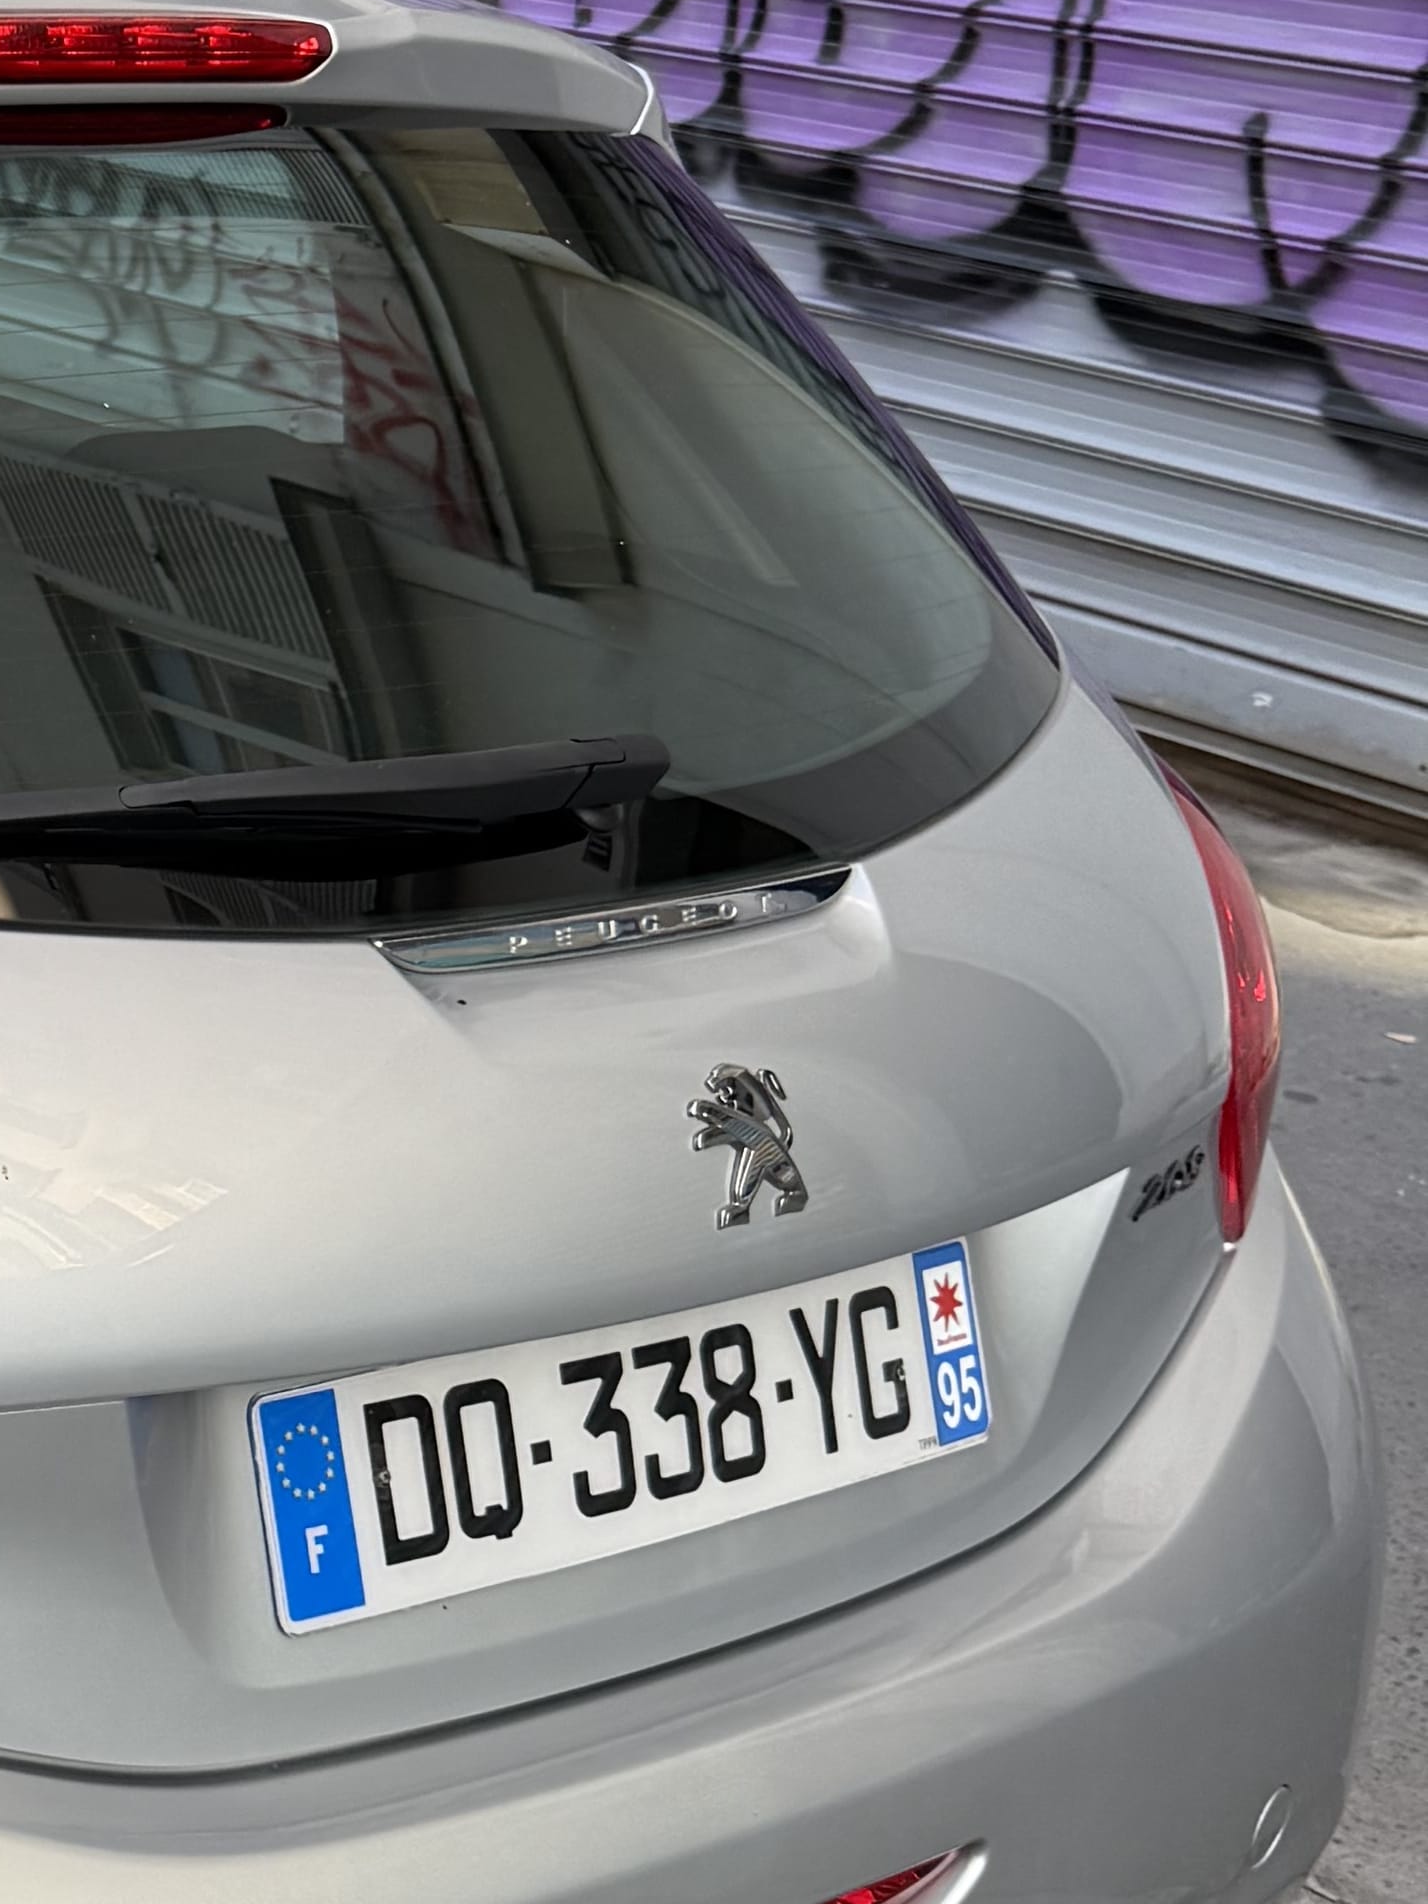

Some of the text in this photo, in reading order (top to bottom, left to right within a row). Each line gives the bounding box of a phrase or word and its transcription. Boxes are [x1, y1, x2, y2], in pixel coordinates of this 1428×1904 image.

[509, 892, 790, 954] PEUGEOT
[937, 1353, 982, 1429] 95
[363, 1286, 912, 1566] DQ-338-YG
[304, 1524, 328, 1575] F
